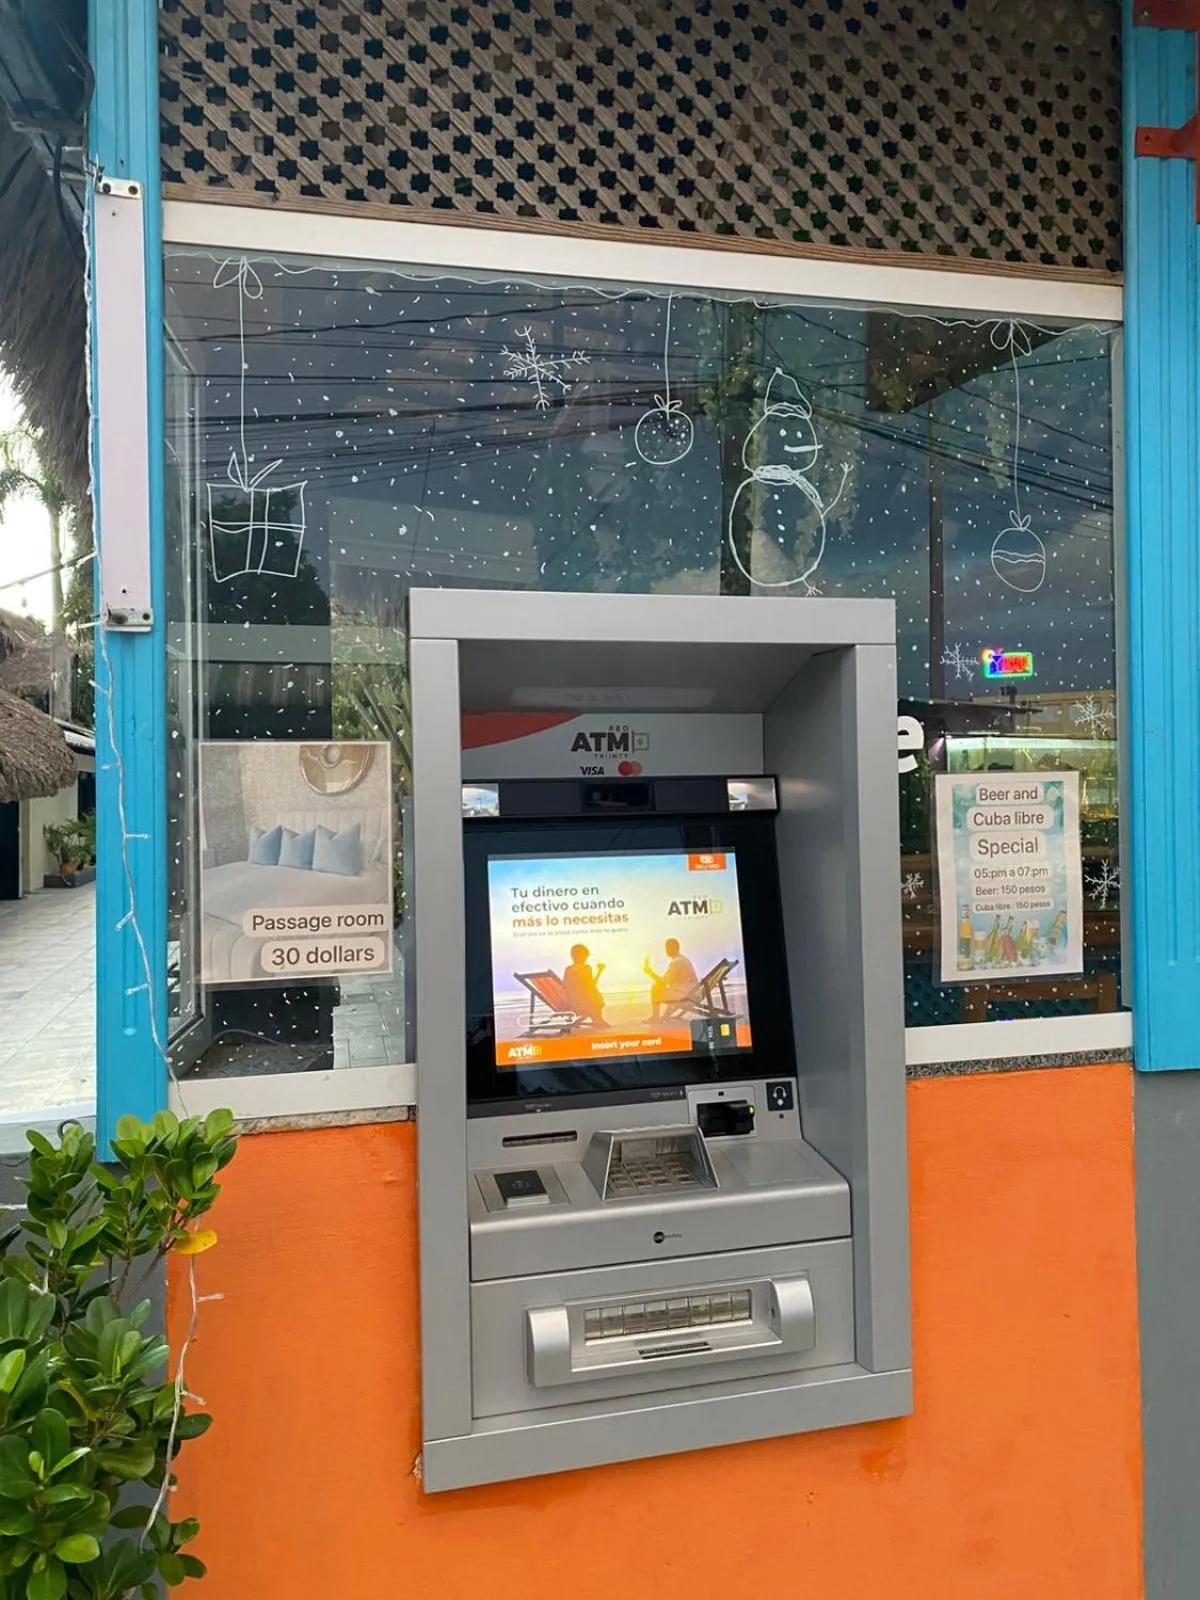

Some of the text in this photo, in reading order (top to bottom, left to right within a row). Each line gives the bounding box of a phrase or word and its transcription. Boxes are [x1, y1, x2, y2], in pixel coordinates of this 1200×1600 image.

[570, 732, 629, 752] ATM
[580, 765, 605, 776] VISA
[979, 786, 1038, 801] Beer and
[973, 811, 1044, 826] Cuba libre
[977, 836, 1039, 858] Special
[974, 866, 1049, 879] 05:pm a 07:pm
[511, 885, 600, 898] Tu dinero en
[975, 884, 1046, 896] Beer: 150 pesos
[511, 898, 625, 913] efectivo cuando
[668, 900, 708, 916] ATM
[253, 912, 385, 932] Passage room
[512, 911, 630, 928] más lo necesitas
[272, 944, 375, 966] 30 dollars
